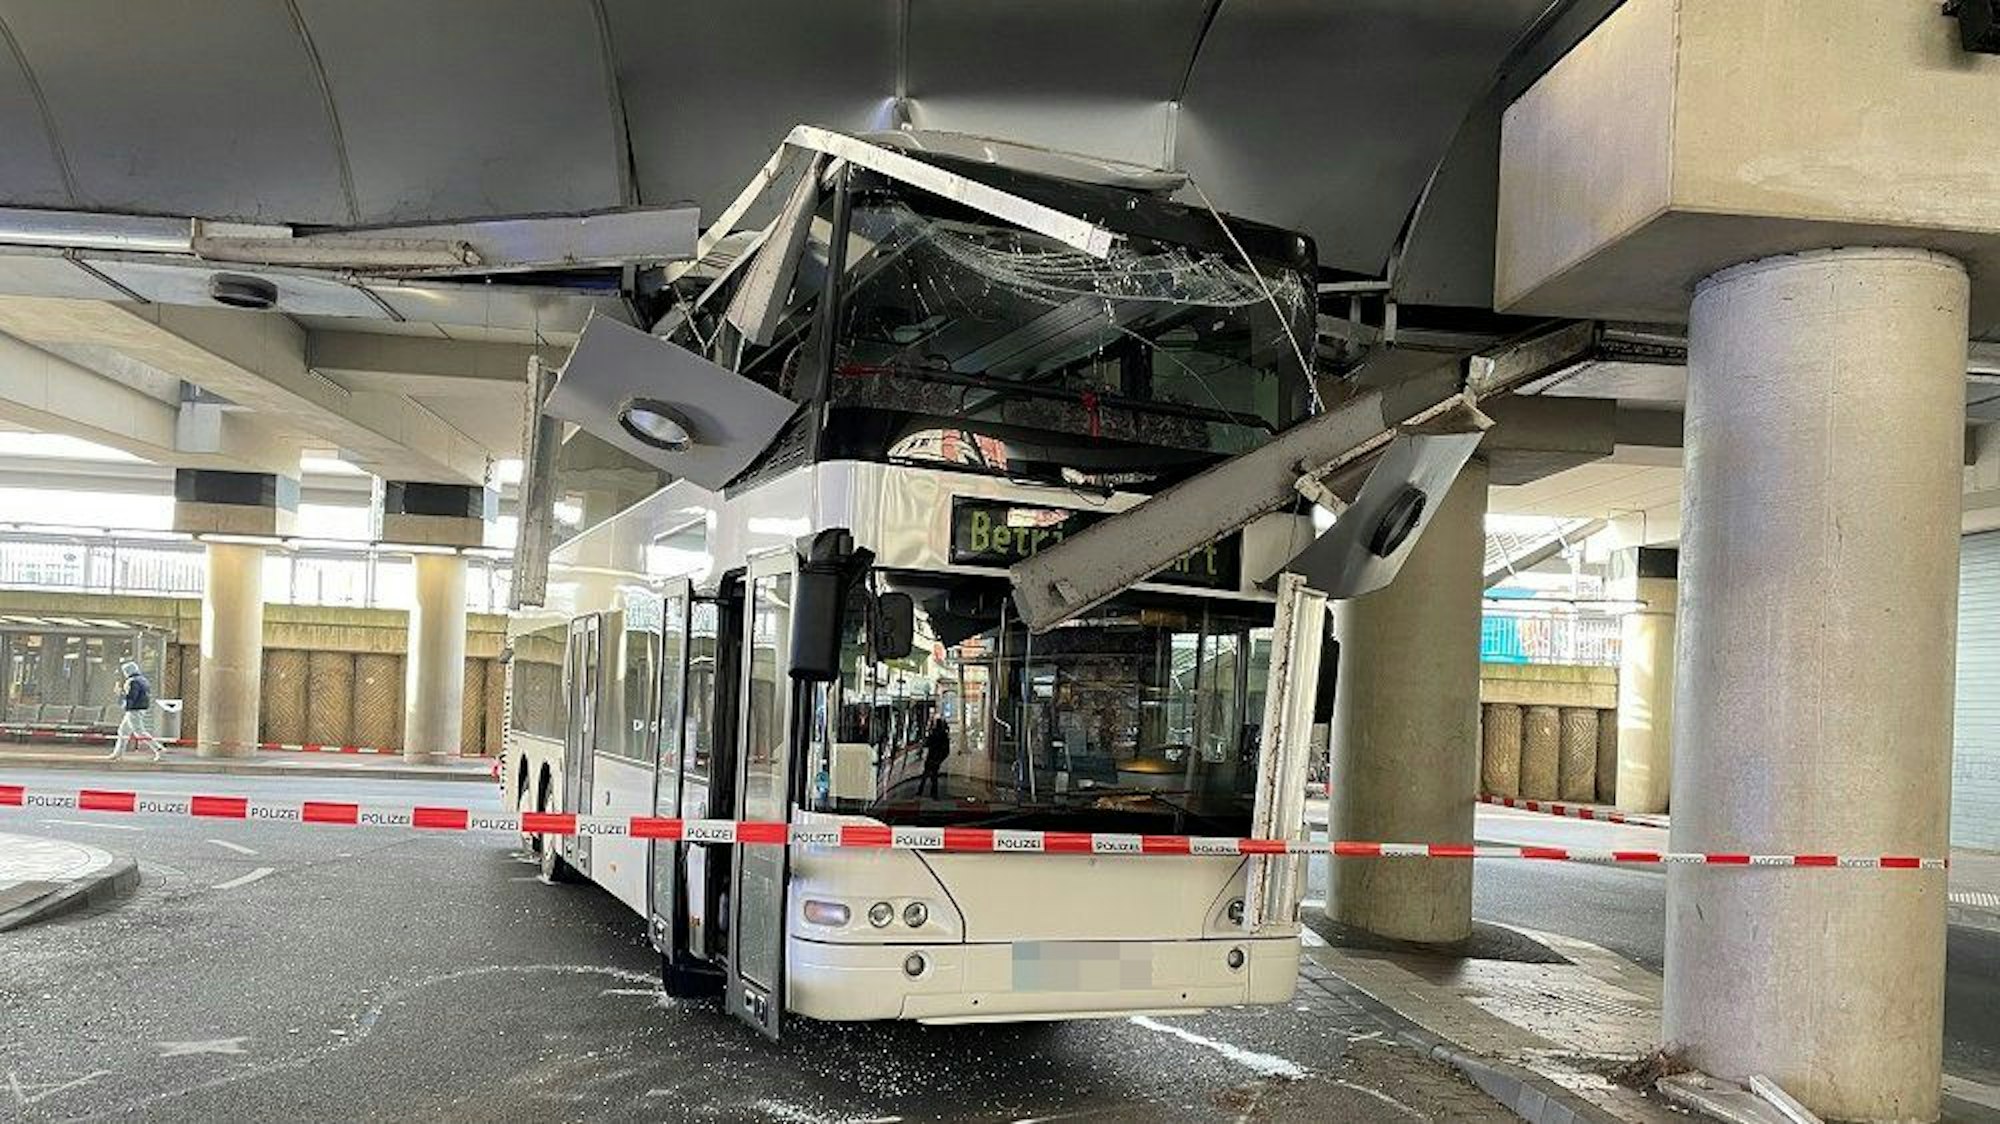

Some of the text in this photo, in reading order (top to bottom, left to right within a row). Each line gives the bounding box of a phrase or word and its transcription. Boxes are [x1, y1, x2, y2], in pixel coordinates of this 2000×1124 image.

[27, 795, 76, 808] POLIZEI
[139, 801, 189, 814] POLIZEI
[251, 807, 300, 820] POLIZEI
[361, 812, 409, 825] POLIZEI
[471, 818, 519, 831] POLIZEI
[580, 823, 627, 836] POLIZEI
[687, 827, 733, 840] POLIZEI
[792, 832, 839, 845] POLIZEI
[896, 835, 941, 847] POLIZEI
[998, 838, 1041, 849] POLIZEI
